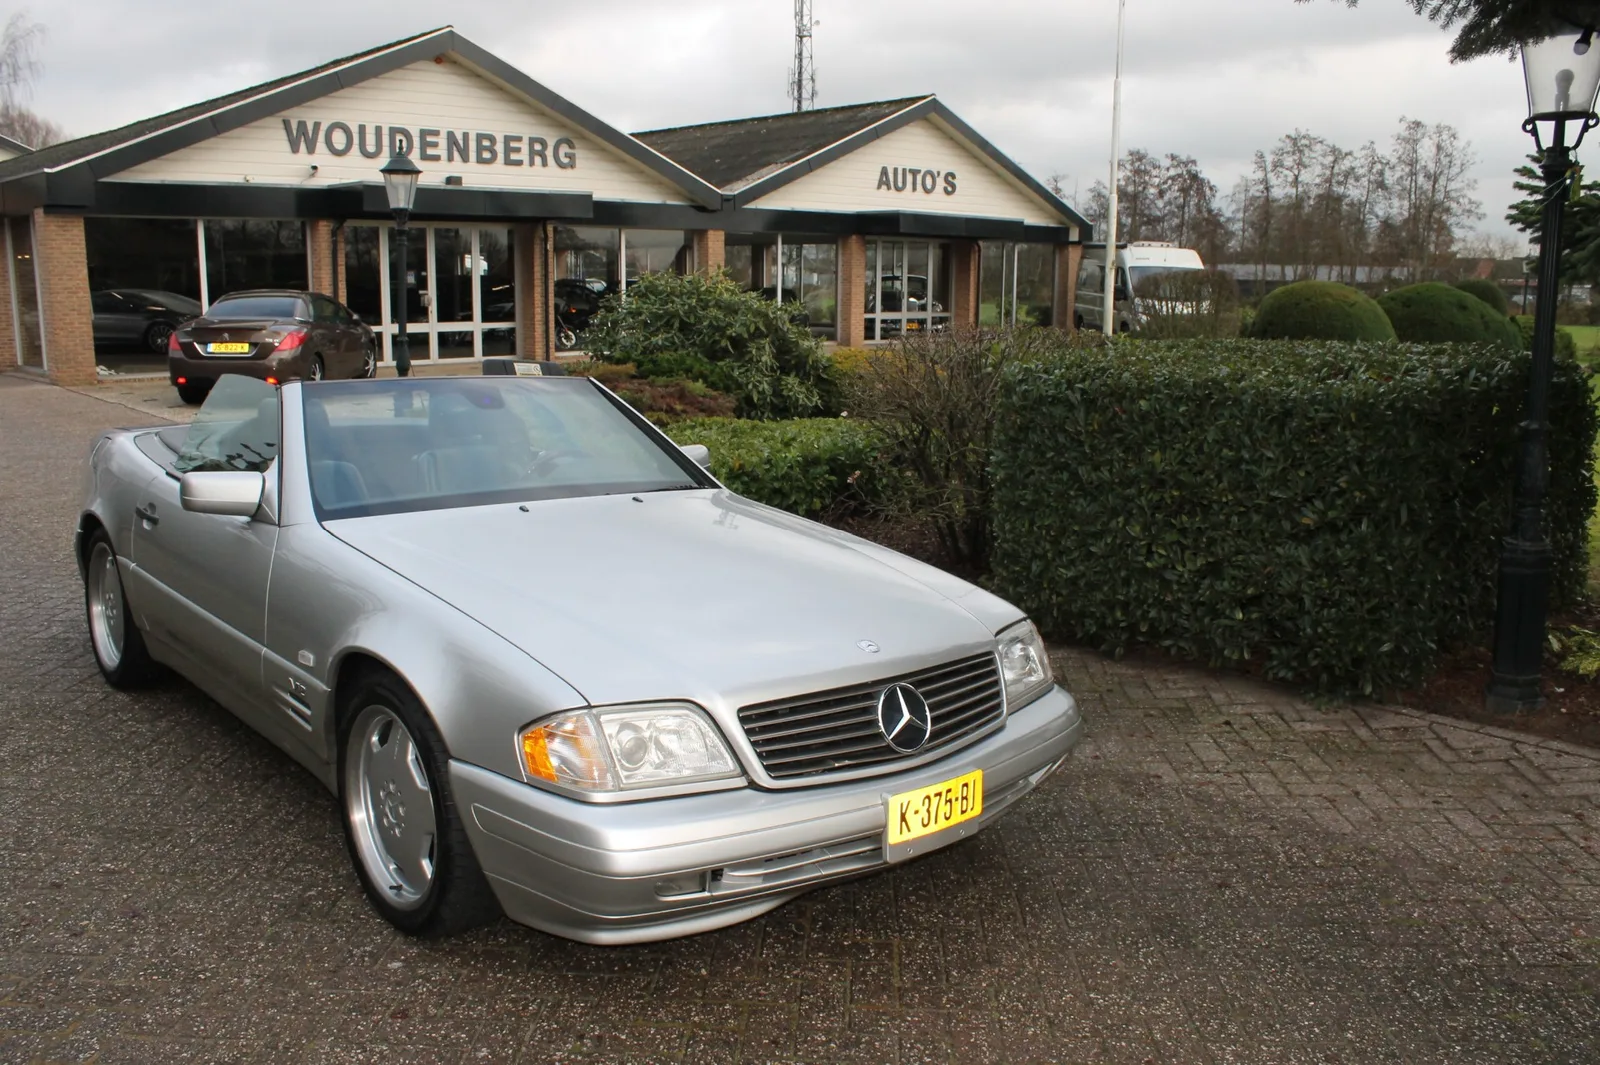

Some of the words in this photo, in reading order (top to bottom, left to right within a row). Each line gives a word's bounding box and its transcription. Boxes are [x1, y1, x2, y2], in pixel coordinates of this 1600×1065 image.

[282, 118, 578, 170] WOUDENBERG
[876, 165, 957, 196] AUTO'S
[899, 778, 977, 836] K-375-BJ
